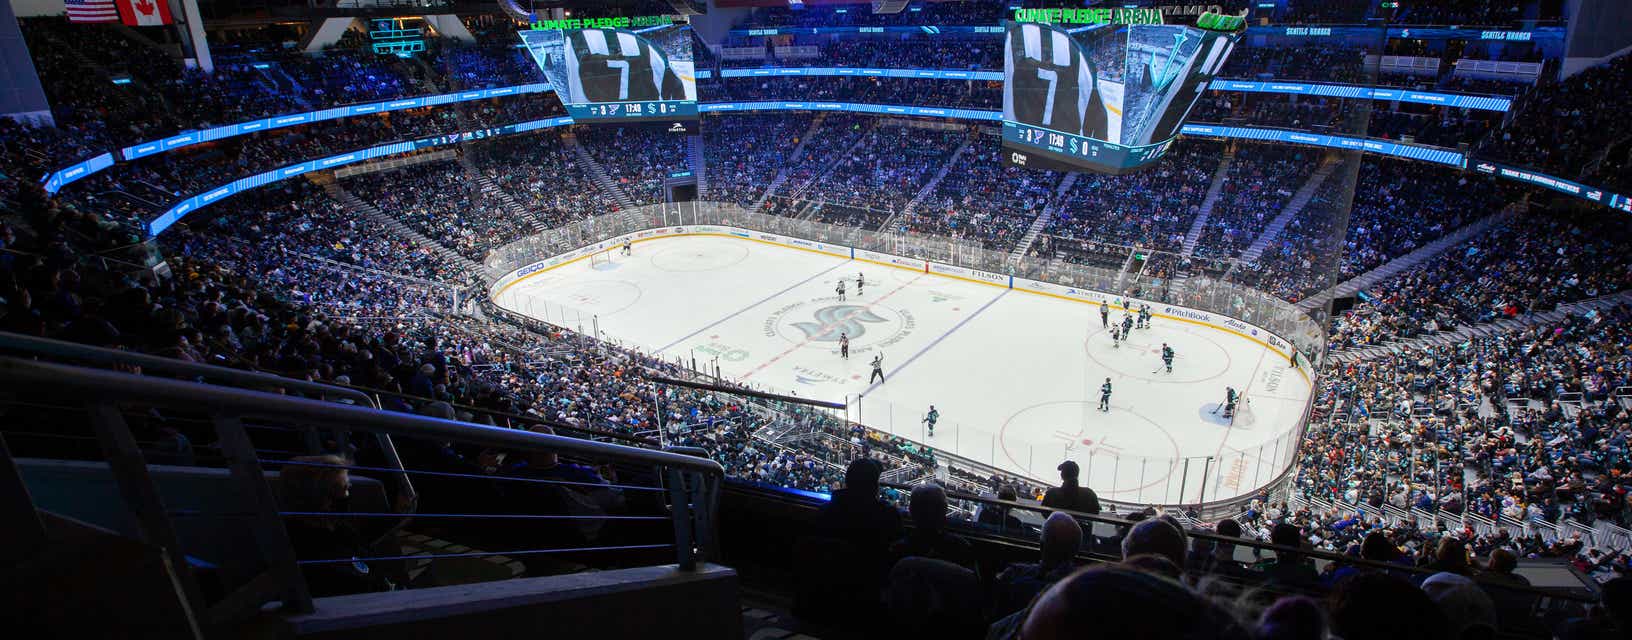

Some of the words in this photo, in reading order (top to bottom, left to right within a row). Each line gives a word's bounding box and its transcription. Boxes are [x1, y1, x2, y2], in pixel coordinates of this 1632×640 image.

[531, 19, 580, 30] CLIMATE
[583, 17, 629, 29] PLEDGE
[632, 15, 673, 27] ARENA
[1015, 9, 1061, 23] CLIMATE
[1062, 9, 1112, 24] PLEDGE
[1112, 9, 1164, 25] ARENA
[1286, 27, 1308, 36] SEATTLE
[1309, 27, 1331, 36] KRAKEN
[1481, 30, 1505, 40] SEATTLE
[1506, 31, 1531, 41] KRAKEN
[607, 60, 630, 100] 7
[1037, 67, 1058, 125] 7
[601, 105, 606, 115] 3
[660, 103, 666, 113] 0
[1026, 129, 1032, 142] 3
[1082, 141, 1088, 156] 0
[1501, 168, 1519, 178] THANK
[1519, 172, 1531, 180] YOU
[1531, 174, 1556, 187] FOUNDING
[1555, 180, 1580, 194] PARTNERS
[517, 262, 545, 277] GEICO
[972, 270, 1004, 281] FILSON
[1171, 308, 1211, 322] PitchBook
